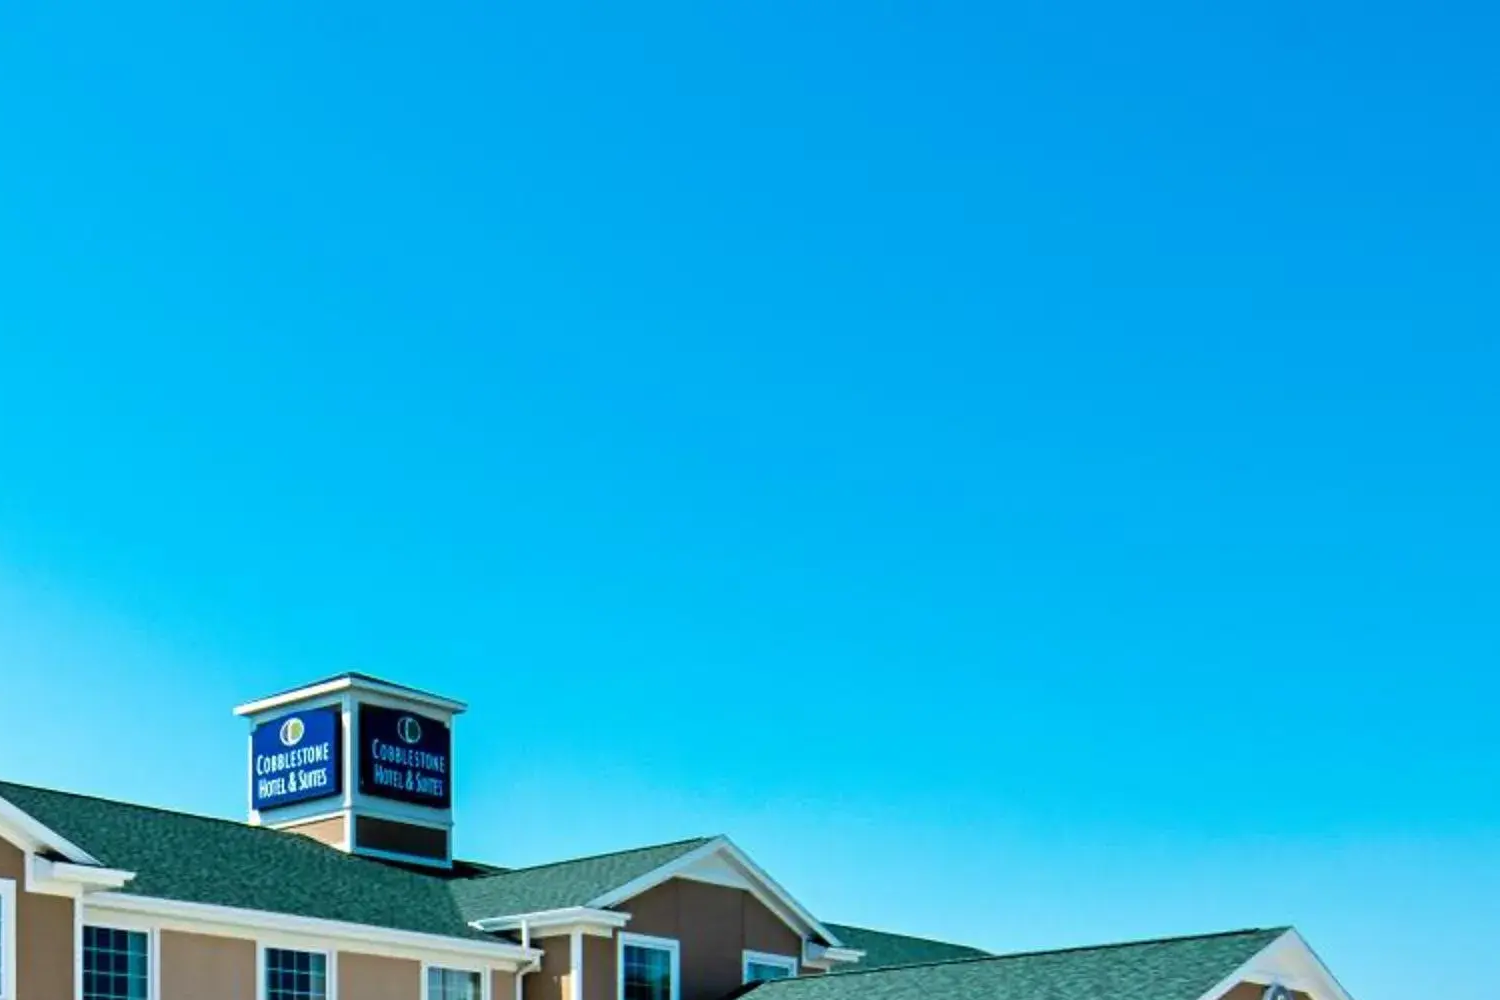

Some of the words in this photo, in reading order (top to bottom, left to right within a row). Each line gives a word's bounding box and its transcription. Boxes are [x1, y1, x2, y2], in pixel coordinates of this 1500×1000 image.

[256, 742, 329, 776] COBBLESTONE
[372, 738, 445, 774] COBBLESTONE
[258, 778, 287, 799] HOTEL
[288, 771, 297, 792] &
[298, 768, 327, 790] SUITES
[374, 763, 404, 790] HOTEL
[405, 769, 414, 790] &
